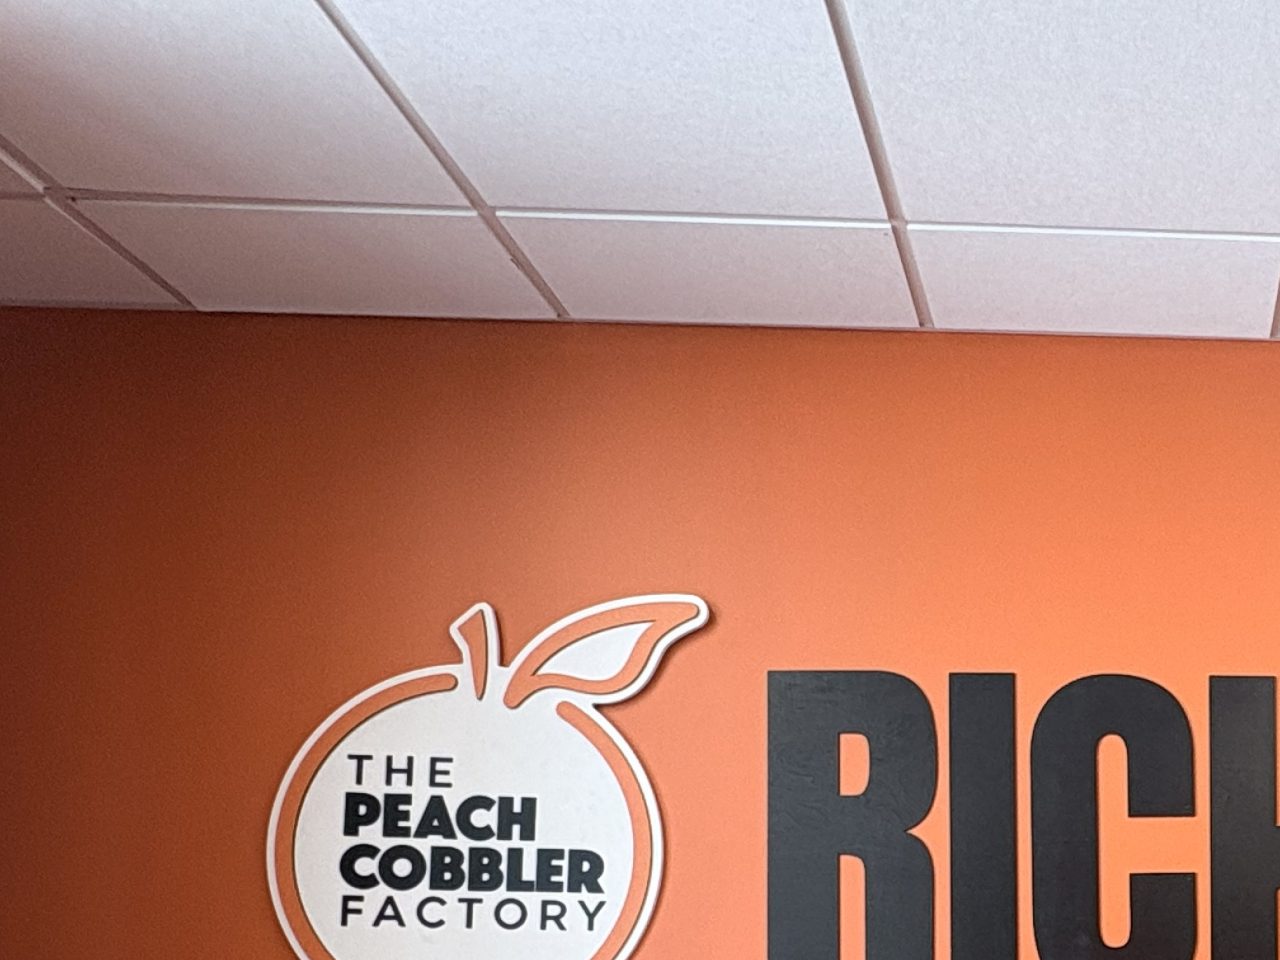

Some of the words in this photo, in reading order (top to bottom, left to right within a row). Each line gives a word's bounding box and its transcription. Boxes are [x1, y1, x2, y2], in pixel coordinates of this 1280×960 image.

[347, 754, 454, 788] THE
[343, 792, 537, 841] PEACH
[339, 843, 605, 894] COBBLER
[340, 895, 606, 931] FACTORY
